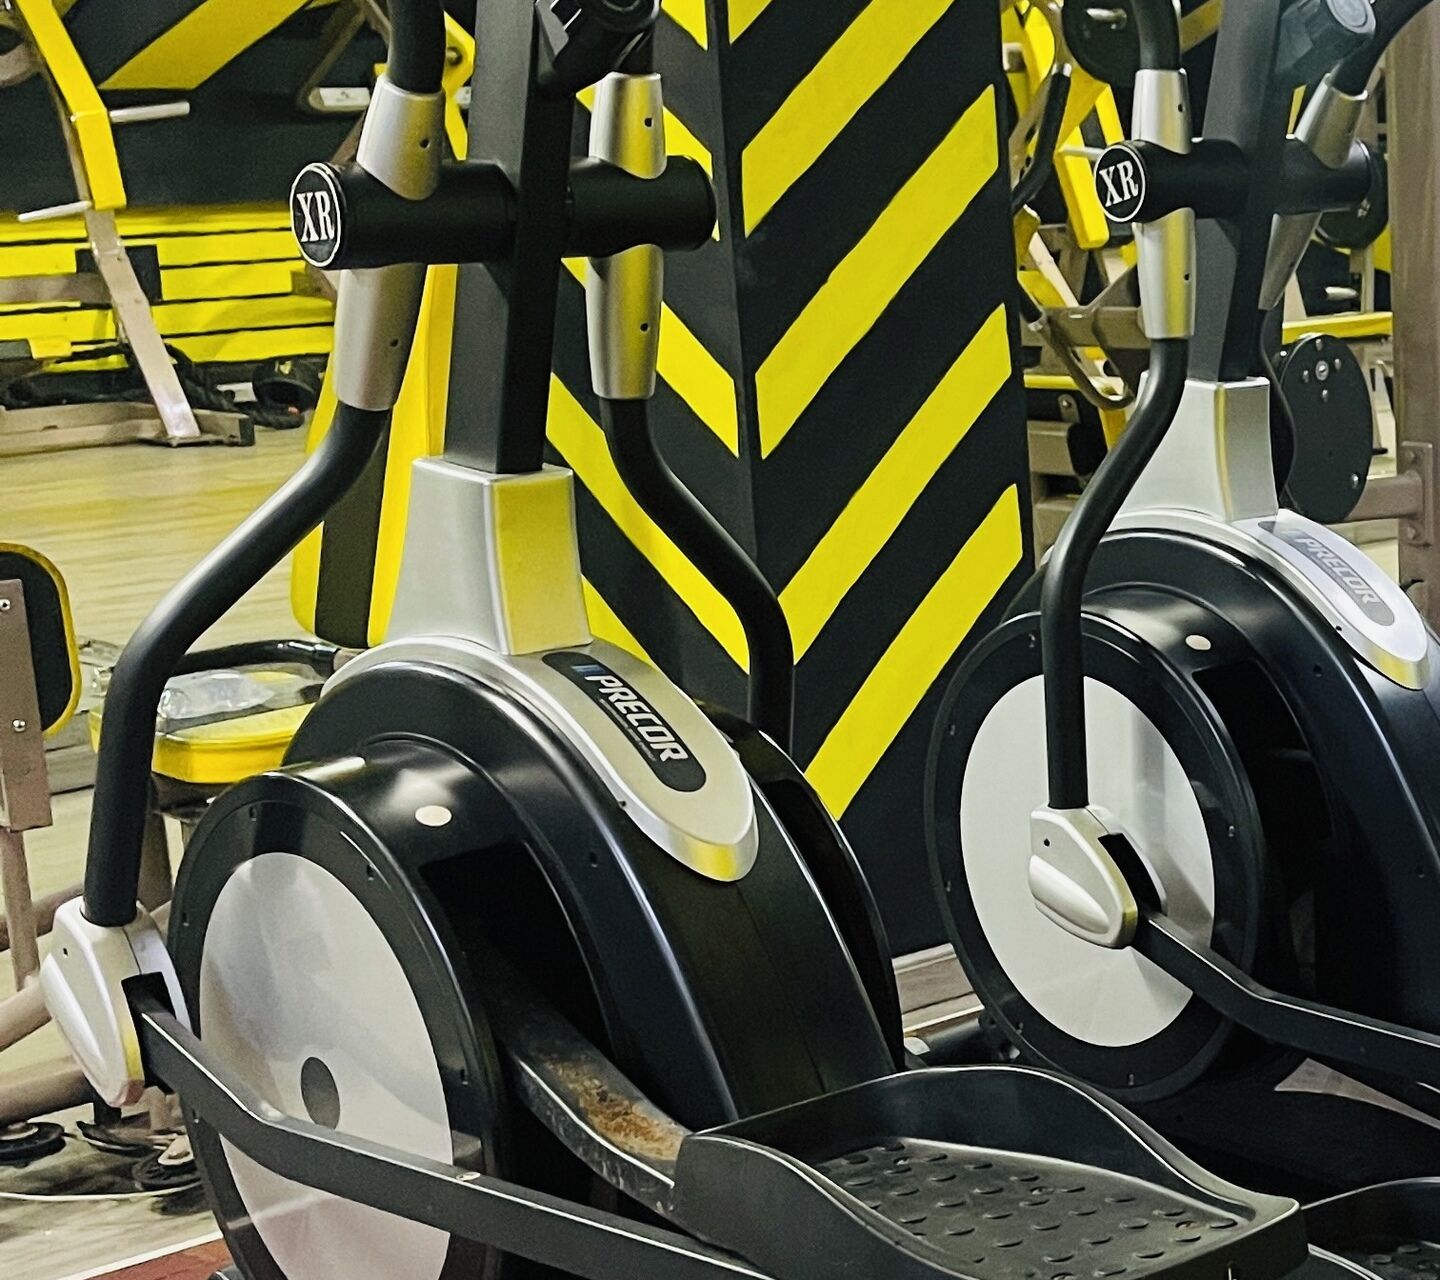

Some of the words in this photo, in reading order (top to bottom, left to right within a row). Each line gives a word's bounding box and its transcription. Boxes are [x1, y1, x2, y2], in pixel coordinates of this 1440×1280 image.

[1098, 160, 1139, 208] XR
[296, 190, 336, 242] XR
[1295, 537, 1378, 605] PRECOR
[584, 675, 689, 762] PRECOR
